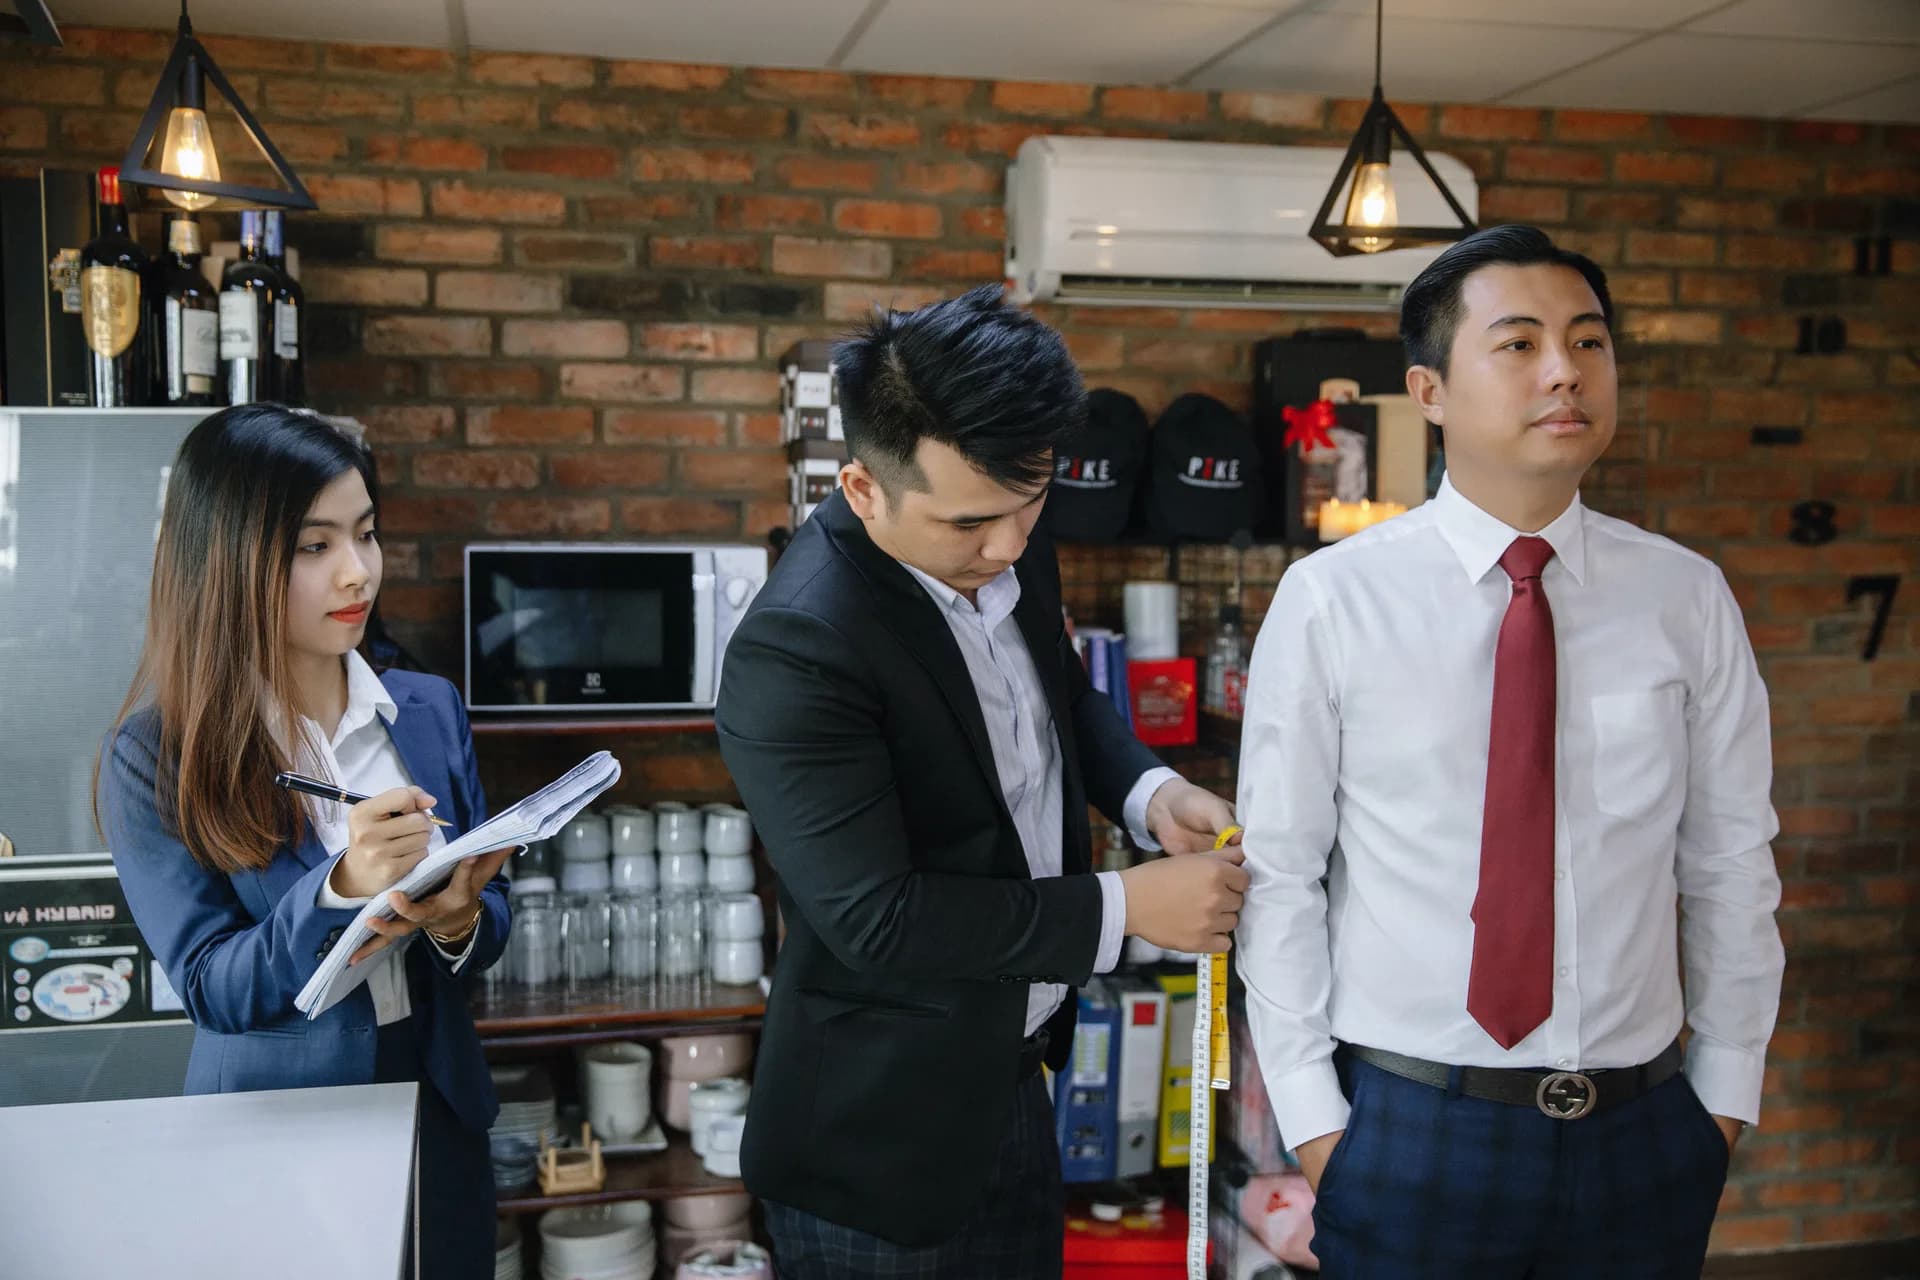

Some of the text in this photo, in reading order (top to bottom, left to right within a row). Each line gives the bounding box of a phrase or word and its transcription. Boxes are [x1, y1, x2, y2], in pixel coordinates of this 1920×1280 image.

[1789, 501, 1838, 547] 8
[1845, 573, 1902, 662] 7
[34, 904, 116, 922] HYBRID
